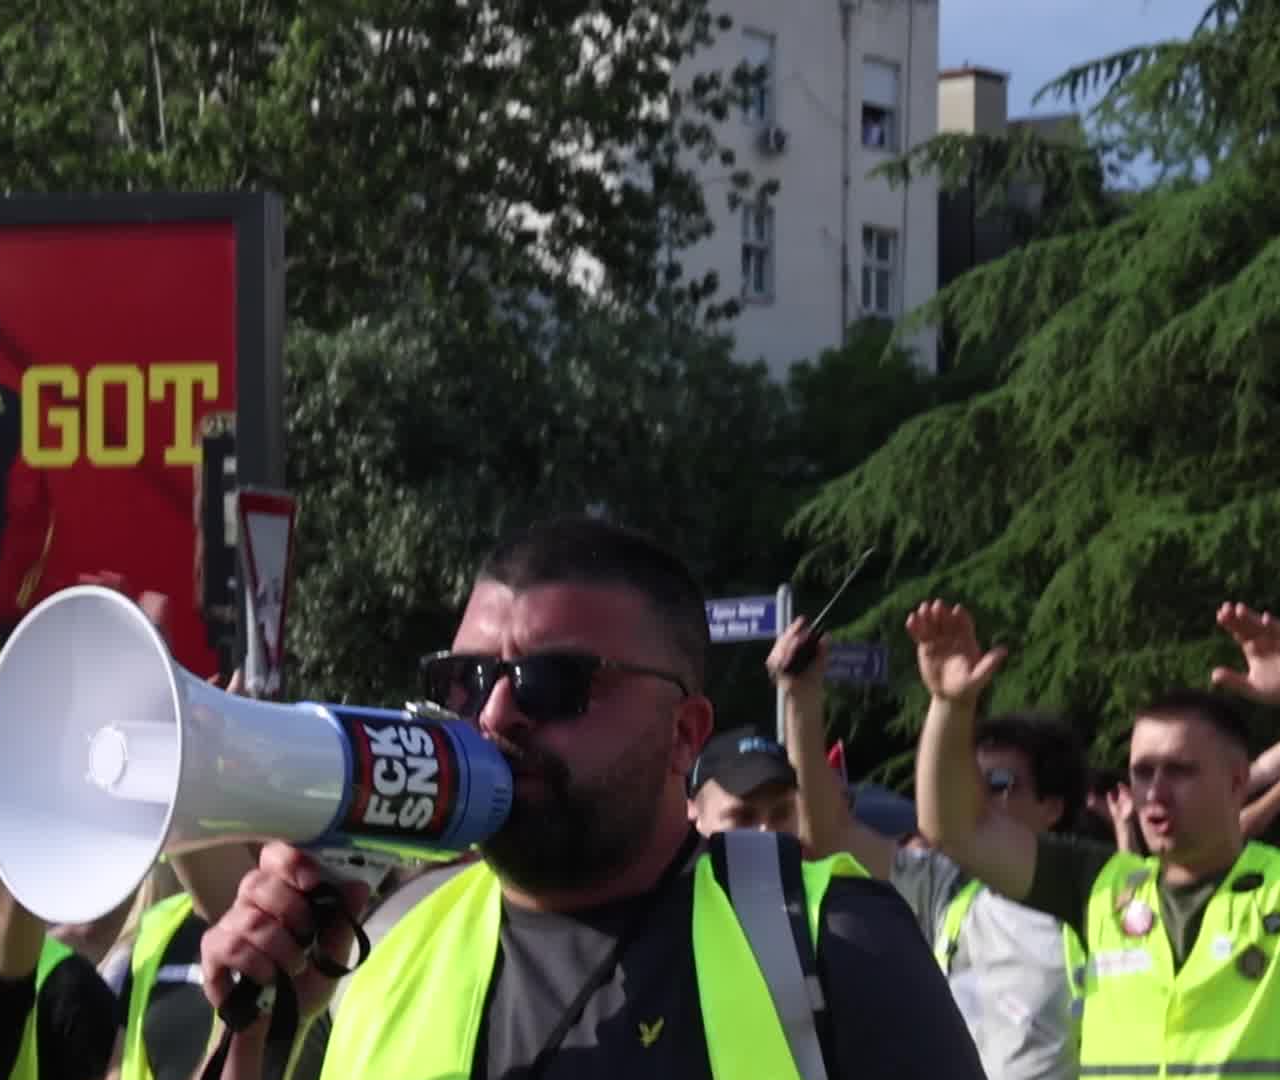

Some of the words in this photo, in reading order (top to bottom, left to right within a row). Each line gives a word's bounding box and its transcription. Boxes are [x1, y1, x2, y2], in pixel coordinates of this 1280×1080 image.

[21, 362, 218, 468] GOT
[364, 724, 409, 828] FCK
[399, 726, 441, 831] SNS
